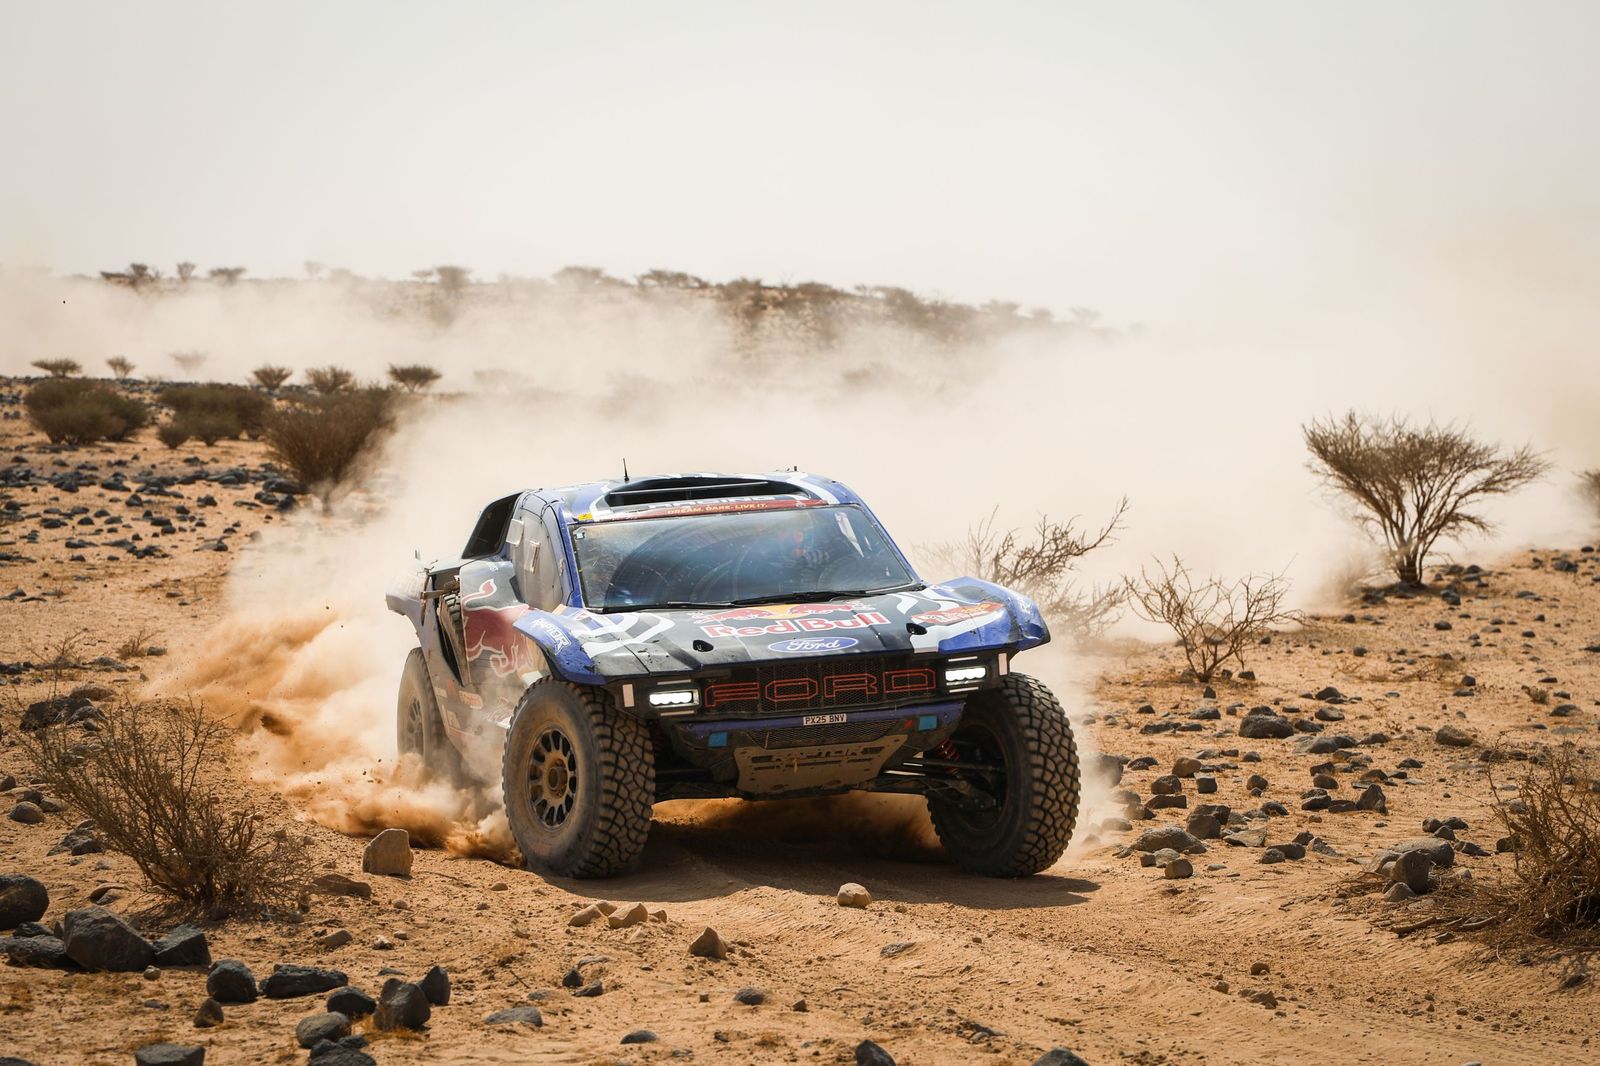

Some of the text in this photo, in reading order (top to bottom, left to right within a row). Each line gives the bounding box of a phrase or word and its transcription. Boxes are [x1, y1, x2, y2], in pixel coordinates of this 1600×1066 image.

[735, 502, 755, 510] LIVE
[702, 620, 799, 638] Red
[796, 611, 891, 631] Bull
[785, 637, 841, 651] Ford
[704, 667, 936, 708] FORD
[805, 713, 845, 725] PX25 BNV
